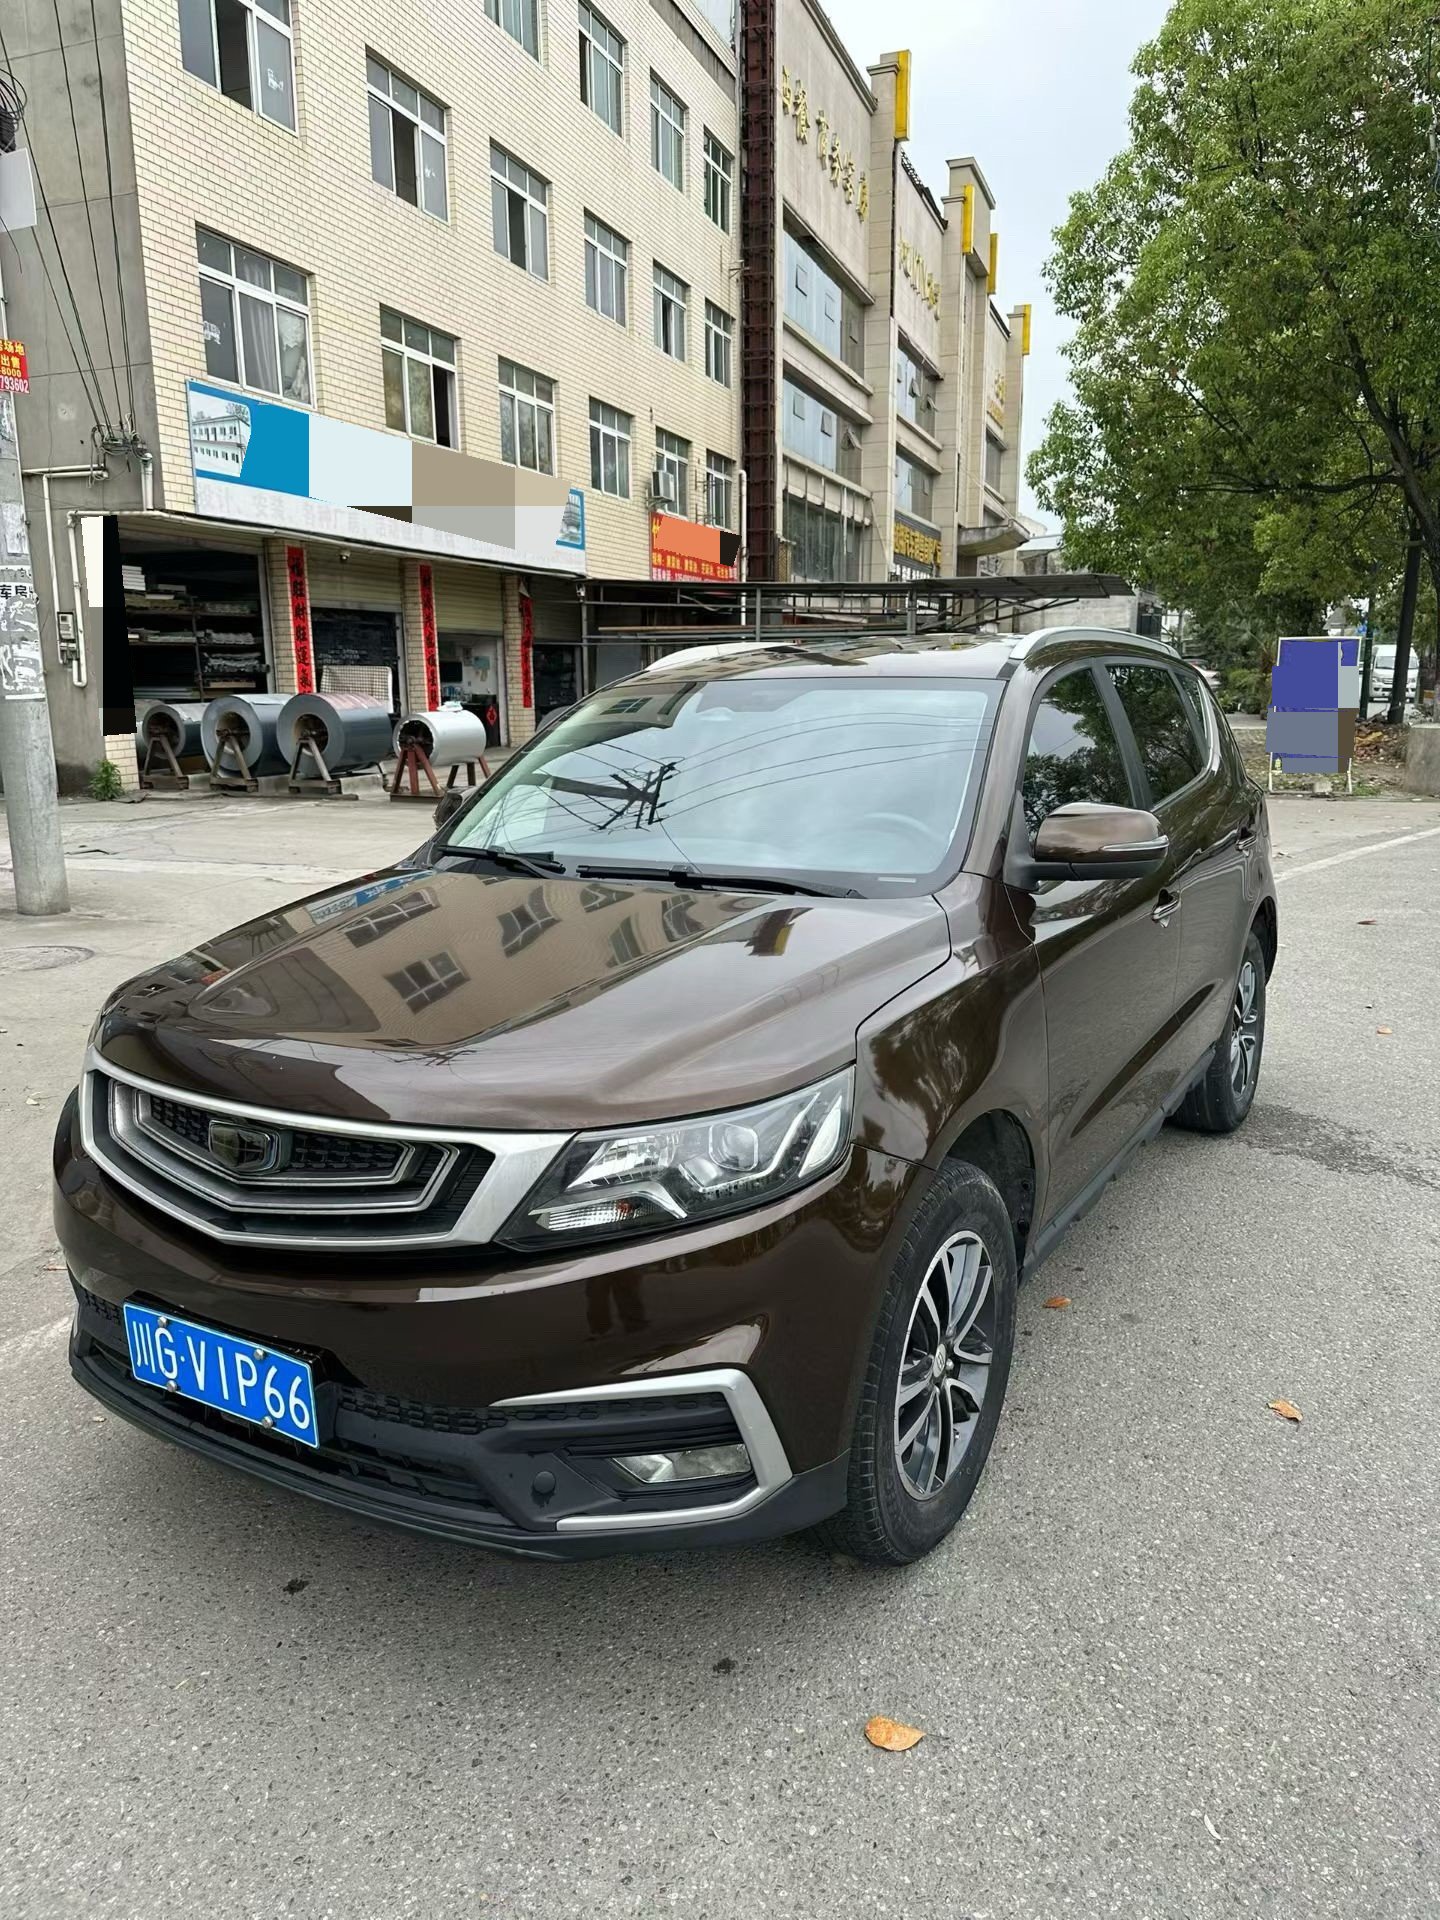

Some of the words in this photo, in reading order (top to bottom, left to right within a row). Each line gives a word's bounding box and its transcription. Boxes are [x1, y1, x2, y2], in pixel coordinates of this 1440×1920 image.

[1, 354, 21, 369] 出售
[0, 375, 30, 393] 793602
[0, 584, 34, 600] 库房
